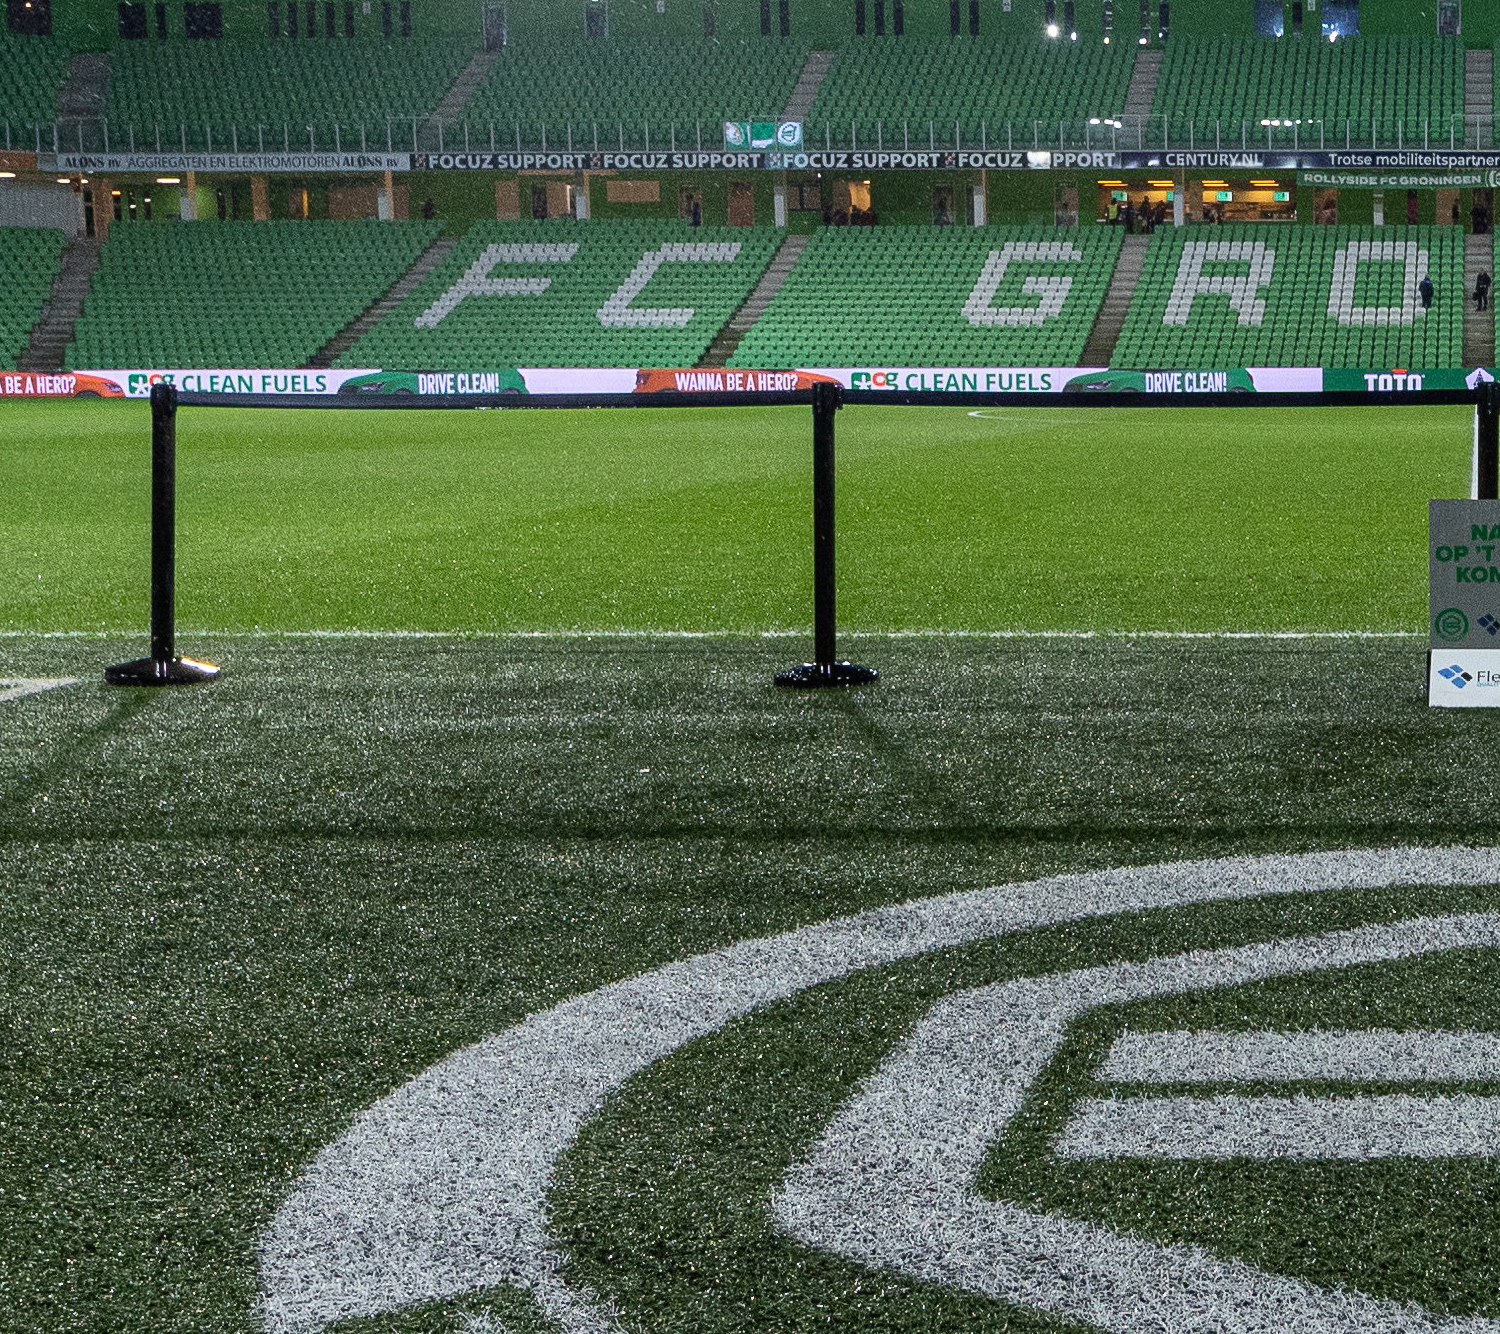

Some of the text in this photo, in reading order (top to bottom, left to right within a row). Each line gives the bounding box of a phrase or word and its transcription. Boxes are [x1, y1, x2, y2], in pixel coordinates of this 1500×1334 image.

[127, 157, 207, 169] AGGREGATEN
[210, 157, 226, 169] EN
[229, 157, 342, 169] ELEKTROMOTOREN
[429, 154, 587, 169] FOCUZ SUPPORT
[604, 154, 762, 169] FOCUZ SUPPORT
[783, 154, 940, 169] FOCUZ SUPPORT
[959, 154, 1023, 169] FOCUZ
[1166, 153, 1264, 167] CENTURY.NL
[1329, 153, 1373, 166] Trotse
[1376, 153, 1500, 169] mobiliteitspartner
[1303, 173, 1481, 186] ROLLYSIDE FC GRONINGEN
[5, 376, 24, 395] BE
[25, 376, 37, 395] A
[37, 375, 77, 395] HERO?
[182, 375, 254, 394] CLEAN
[262, 375, 327, 393] FUELS
[418, 372, 500, 395] DRIVE CLEAN!
[675, 372, 799, 391] WANNA BE A HERO?
[906, 373, 978, 391] CLEAN
[986, 373, 1052, 391] FUELS
[1145, 372, 1228, 393] DRIVE CLEAN!
[1364, 373, 1423, 391] TOTO
[1435, 545, 1468, 563] OP
[1474, 545, 1496, 562] 'T
